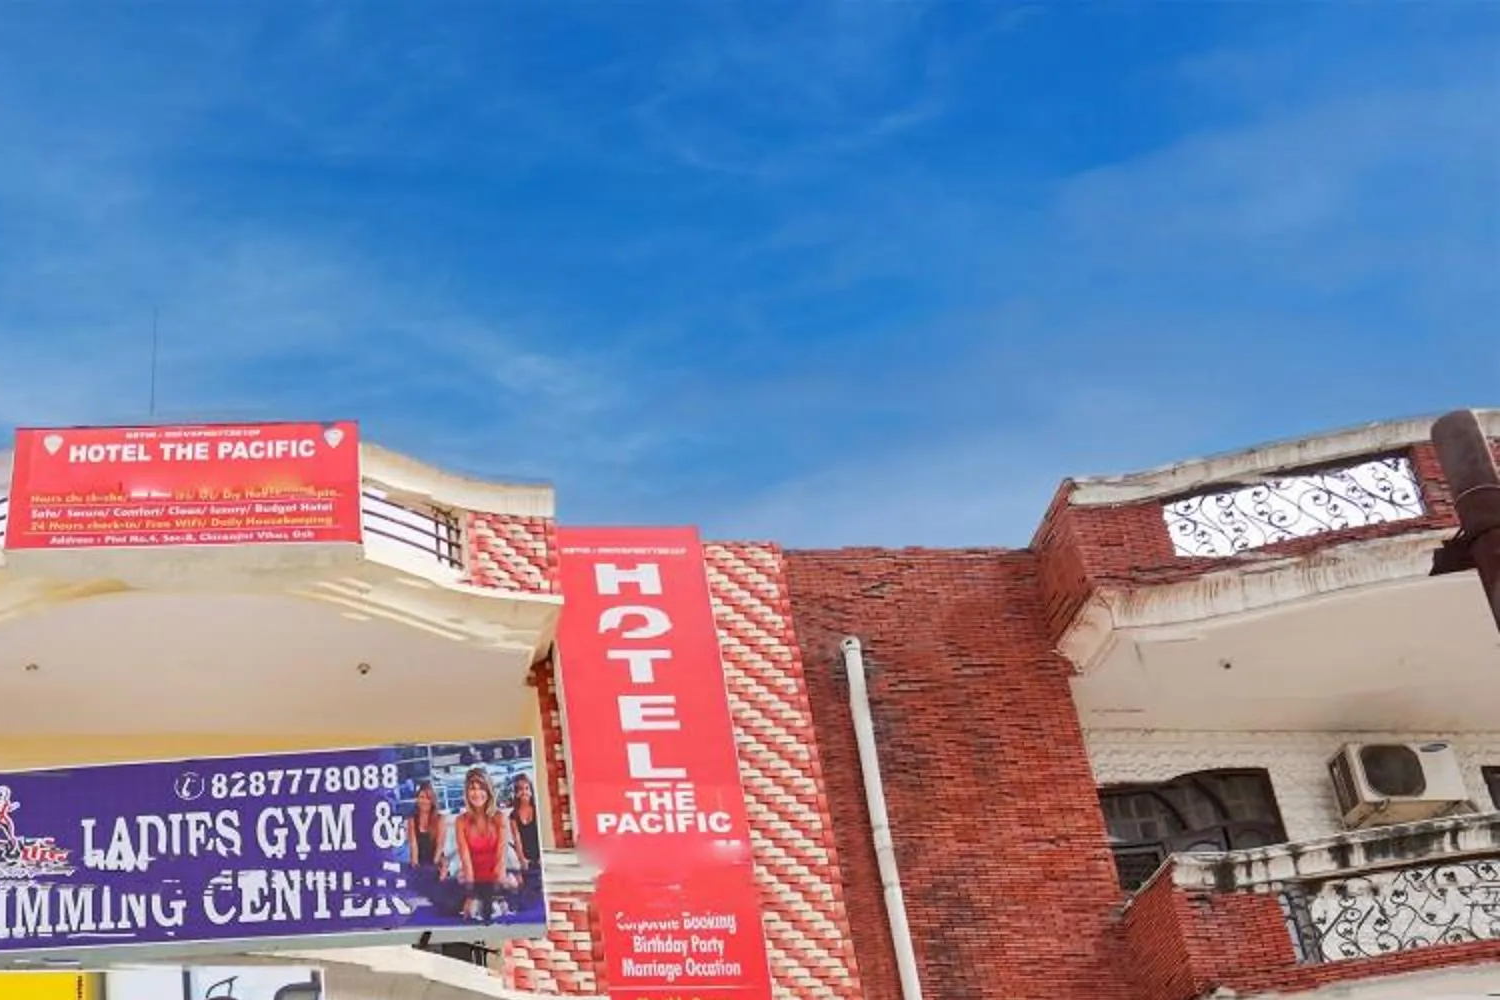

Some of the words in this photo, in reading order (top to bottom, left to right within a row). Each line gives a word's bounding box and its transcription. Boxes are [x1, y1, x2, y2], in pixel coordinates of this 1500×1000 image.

[69, 443, 151, 463] HOTEL
[160, 441, 209, 460] THE
[217, 439, 316, 460] PACIFIC
[594, 563, 687, 779] HOTEL
[209, 764, 398, 799] 8287778088
[625, 783, 697, 812] THE
[256, 803, 357, 859] GYM
[372, 801, 408, 849] &
[596, 812, 732, 834] PACIFIC
[633, 935, 688, 956] Birthday
[691, 935, 725, 955] Party
[622, 958, 683, 982] Marriage
